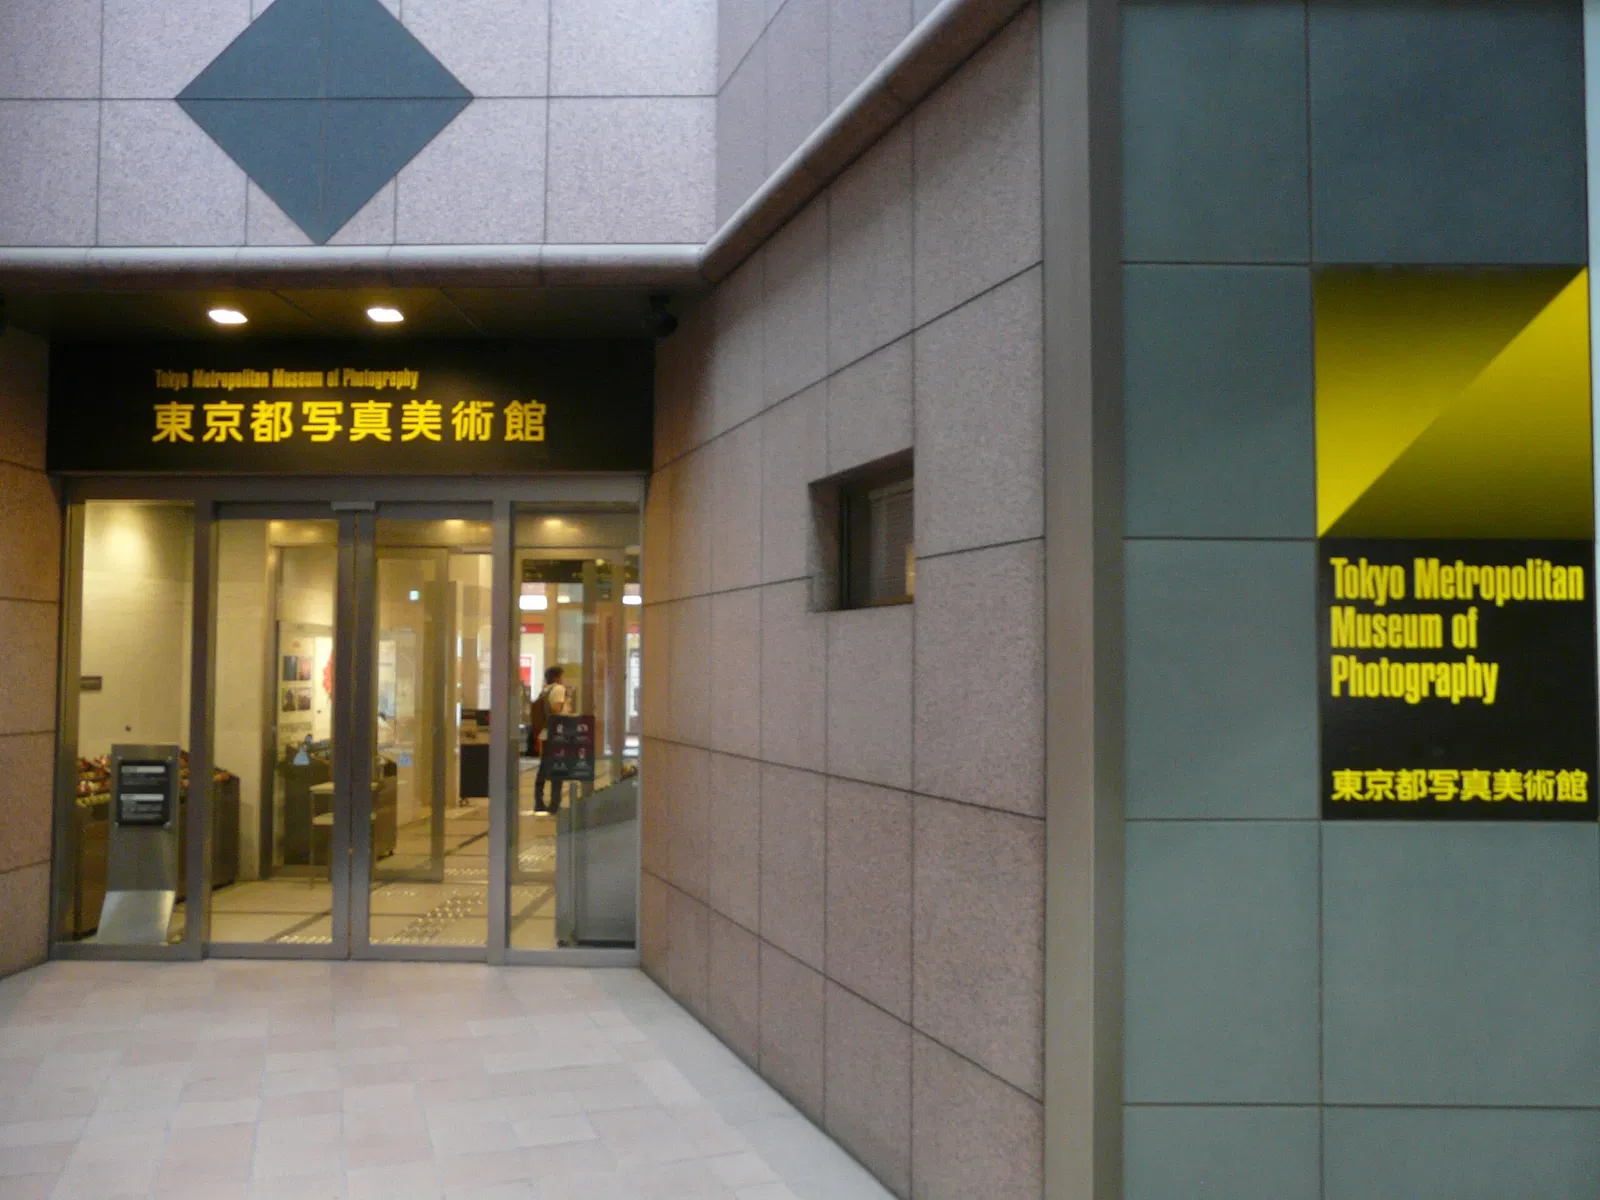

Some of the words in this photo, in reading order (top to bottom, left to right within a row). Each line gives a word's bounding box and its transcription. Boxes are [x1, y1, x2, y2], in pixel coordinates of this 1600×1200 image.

[154, 368, 189, 391] Tokyo
[192, 368, 270, 391] Metropolitan
[272, 368, 324, 388] Museum
[326, 368, 340, 388] of
[342, 368, 419, 390] Photography
[152, 400, 547, 442] 東京都写真美術館
[1330, 557, 1405, 606] Tokyo
[1414, 557, 1584, 606] Metropolitan
[1331, 606, 1443, 648] Museum
[1452, 606, 1478, 648] of
[1331, 655, 1499, 704] Photography
[1332, 768, 1588, 802] 東京都写真美術館
